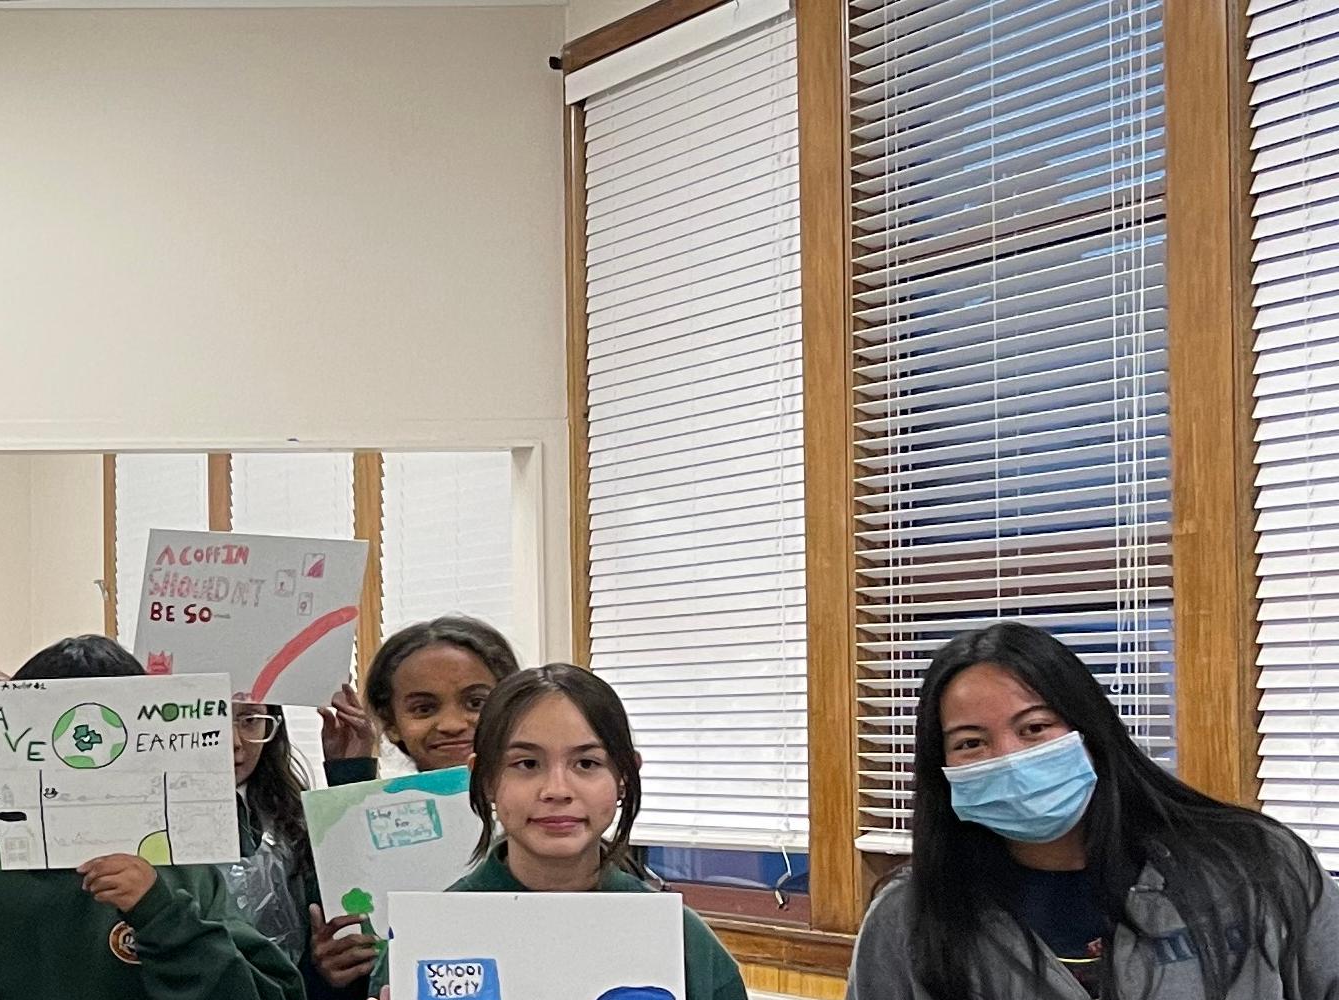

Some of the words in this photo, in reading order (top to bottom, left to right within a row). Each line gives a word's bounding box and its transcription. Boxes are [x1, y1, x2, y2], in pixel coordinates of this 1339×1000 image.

[179, 544, 250, 566] COFFIN
[150, 601, 175, 621] BE
[137, 699, 228, 722] MOTHER
